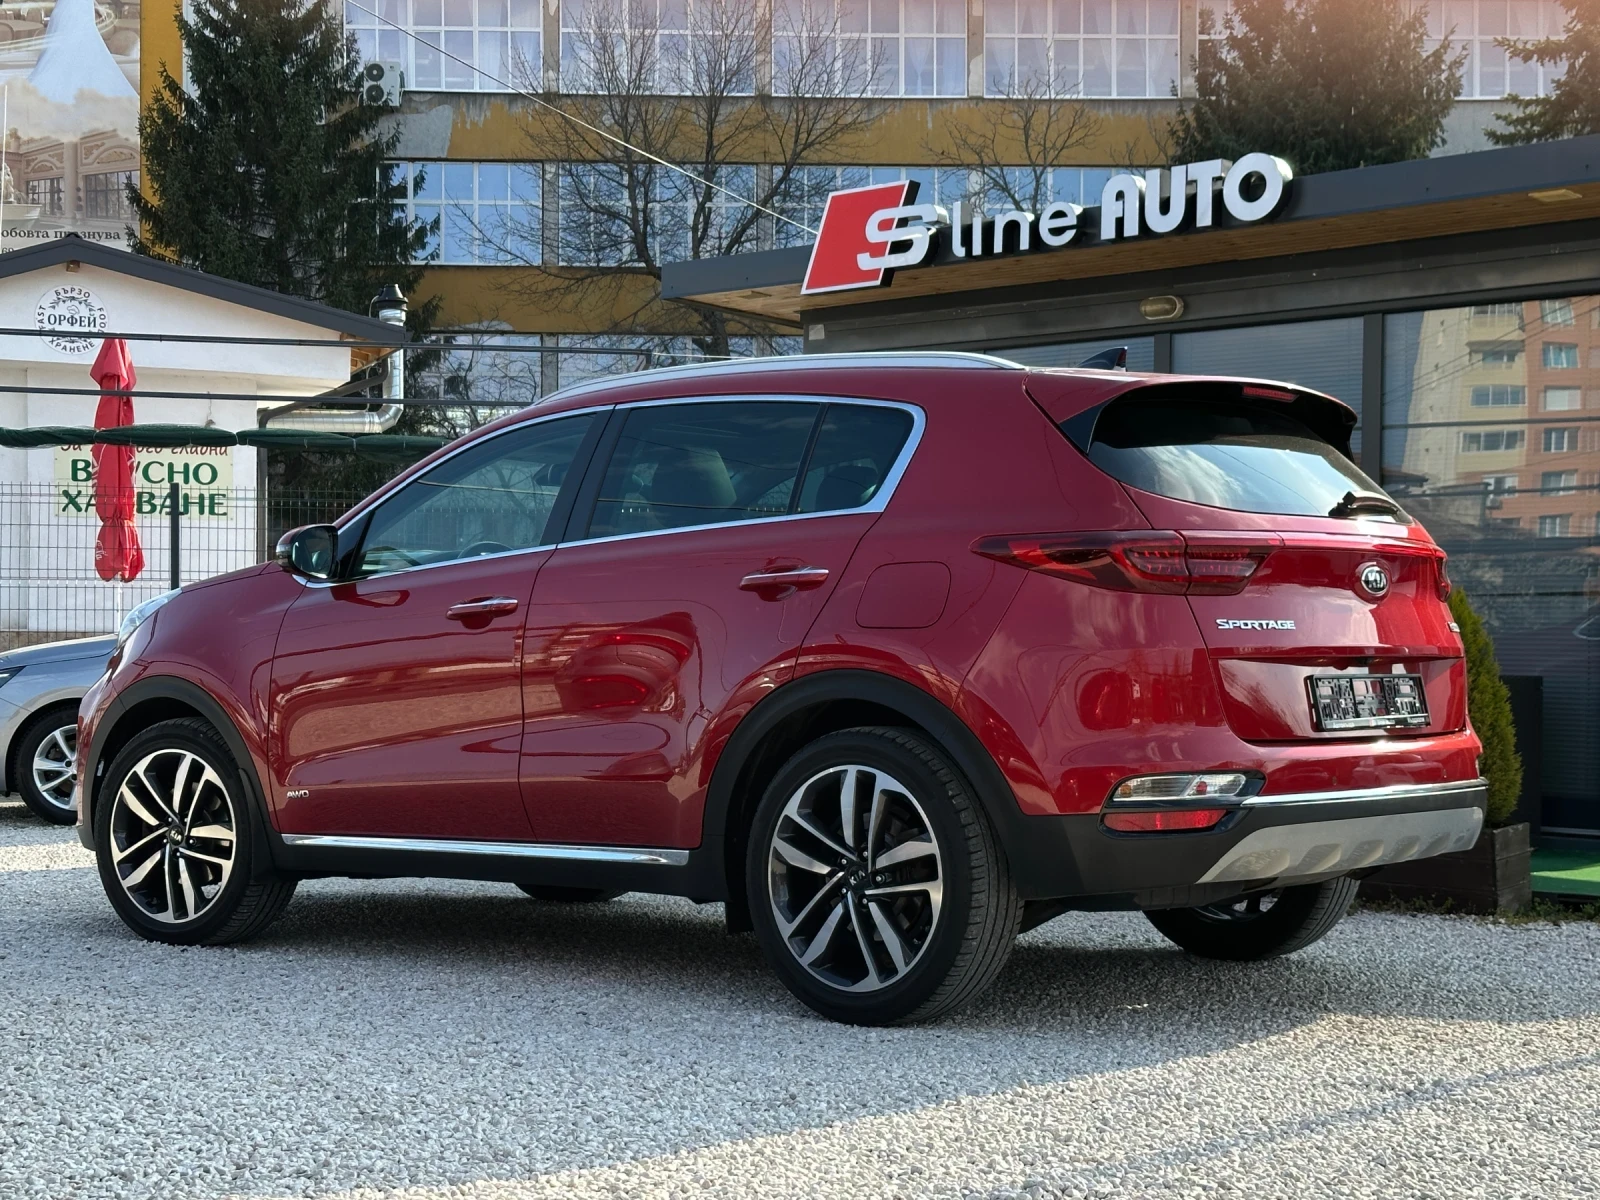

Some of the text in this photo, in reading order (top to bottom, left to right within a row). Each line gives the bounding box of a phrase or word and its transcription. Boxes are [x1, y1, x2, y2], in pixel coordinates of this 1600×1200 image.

[857, 152, 1287, 271] S line AUTO
[54, 286, 91, 299] БЪРЗО
[47, 313, 97, 328] ОРФЕЙ
[49, 337, 95, 353] ХРАНЕНЕ
[71, 459, 219, 485] ВСНО
[1215, 619, 1297, 631] SPORTAGE
[286, 790, 310, 799] AWD
[170, 829, 182, 842] KIA
[849, 870, 866, 886] KIA
